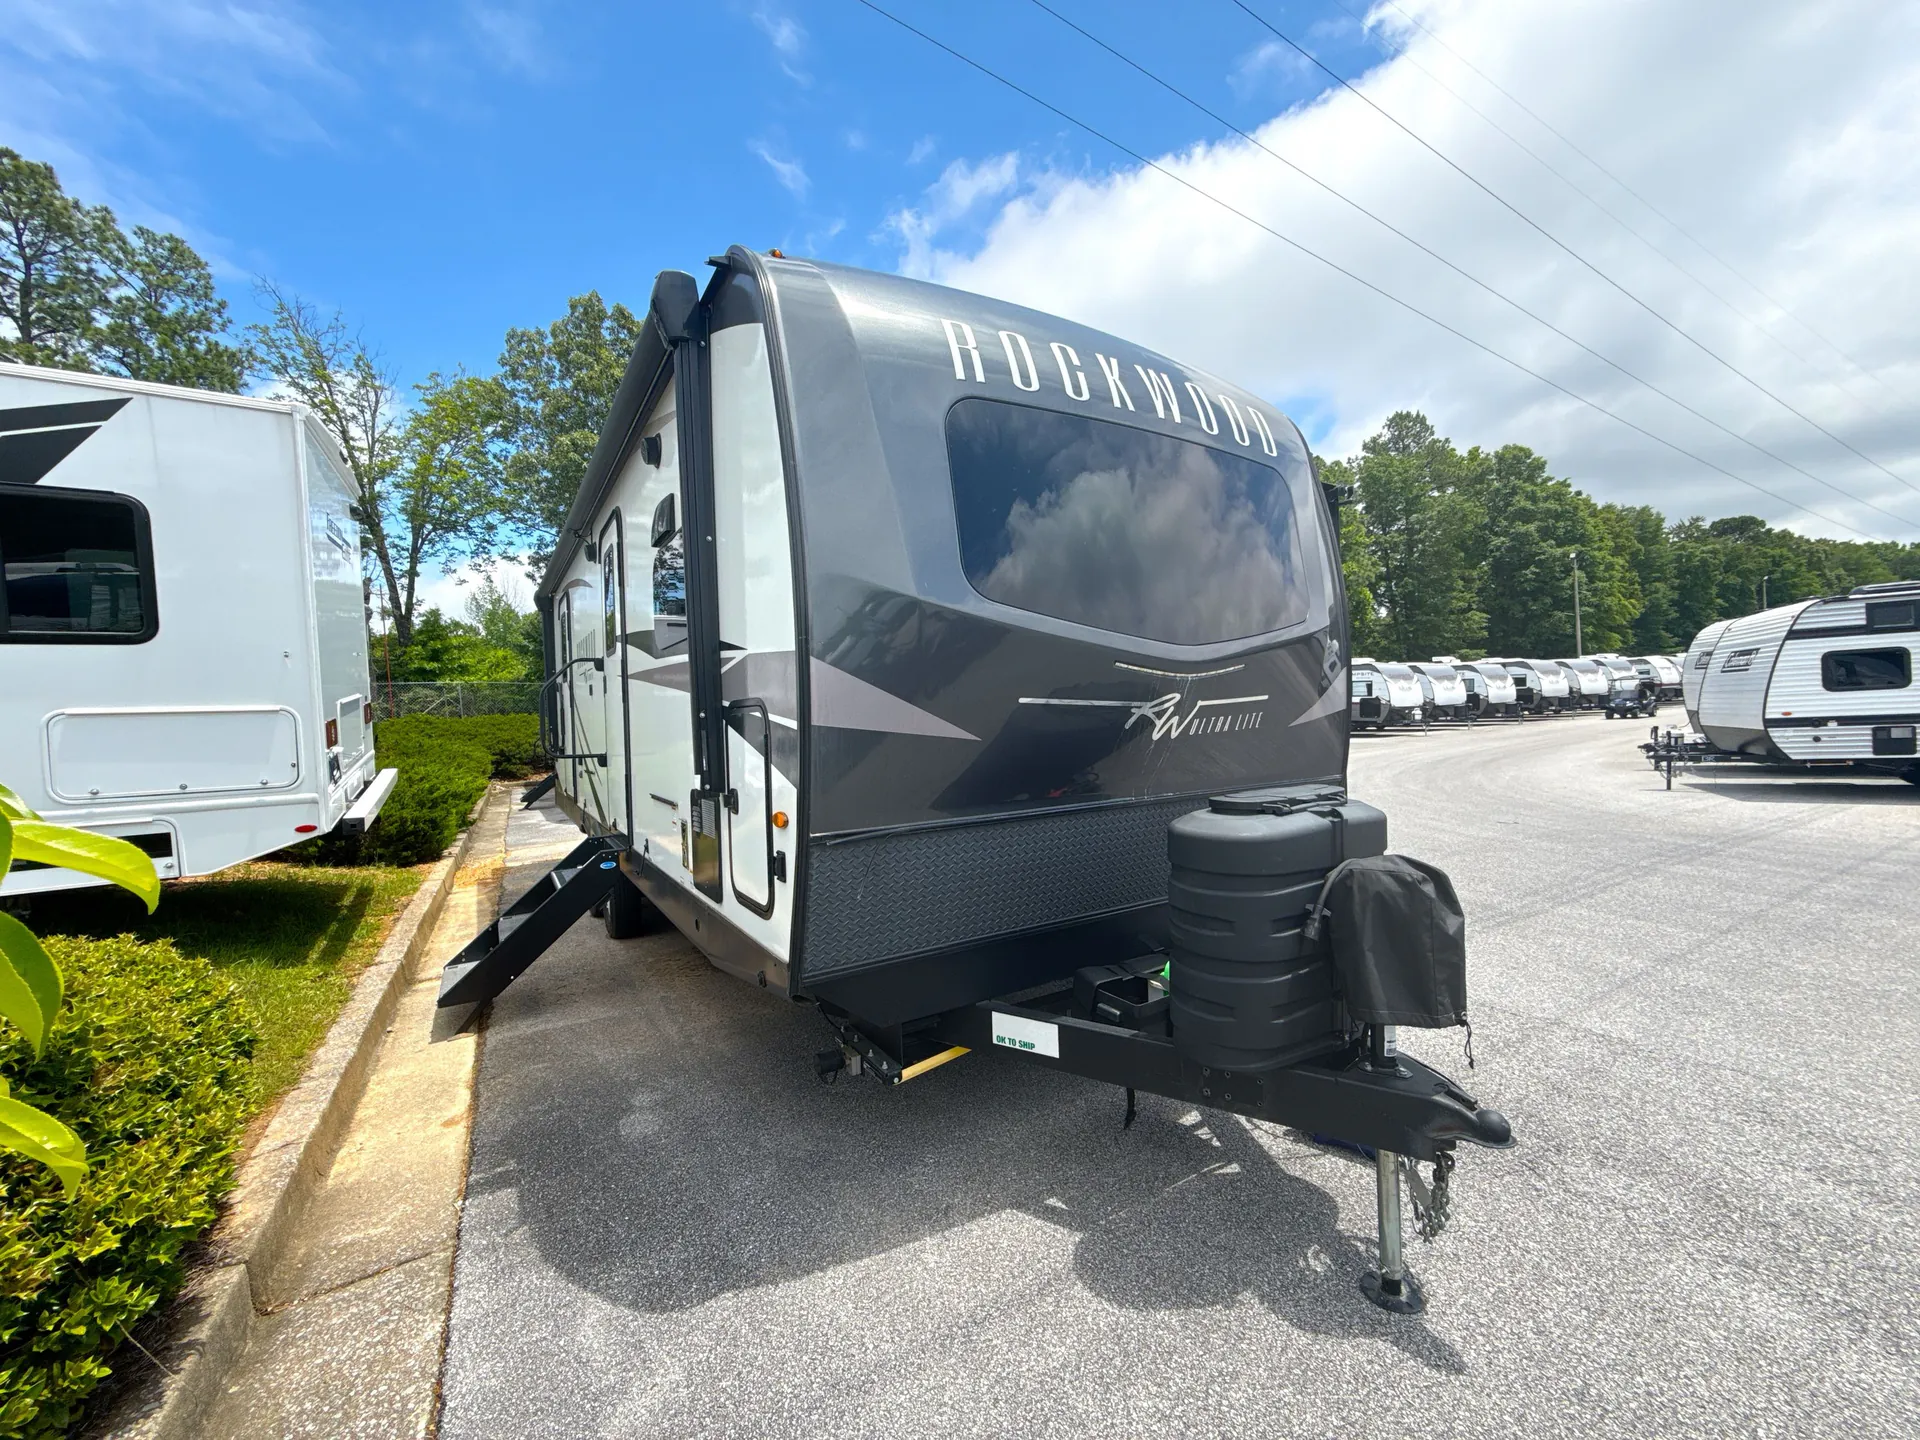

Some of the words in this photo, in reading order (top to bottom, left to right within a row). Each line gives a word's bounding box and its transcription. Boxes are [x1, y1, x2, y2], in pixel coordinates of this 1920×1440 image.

[940, 318, 1278, 458] ROCKWOOD
[1189, 715, 1232, 735] ULTRA
[1235, 711, 1263, 731] LITE
[996, 1035, 1006, 1044] OK
[1007, 1037, 1017, 1047] TO
[1018, 1039, 1035, 1050] SHIP
